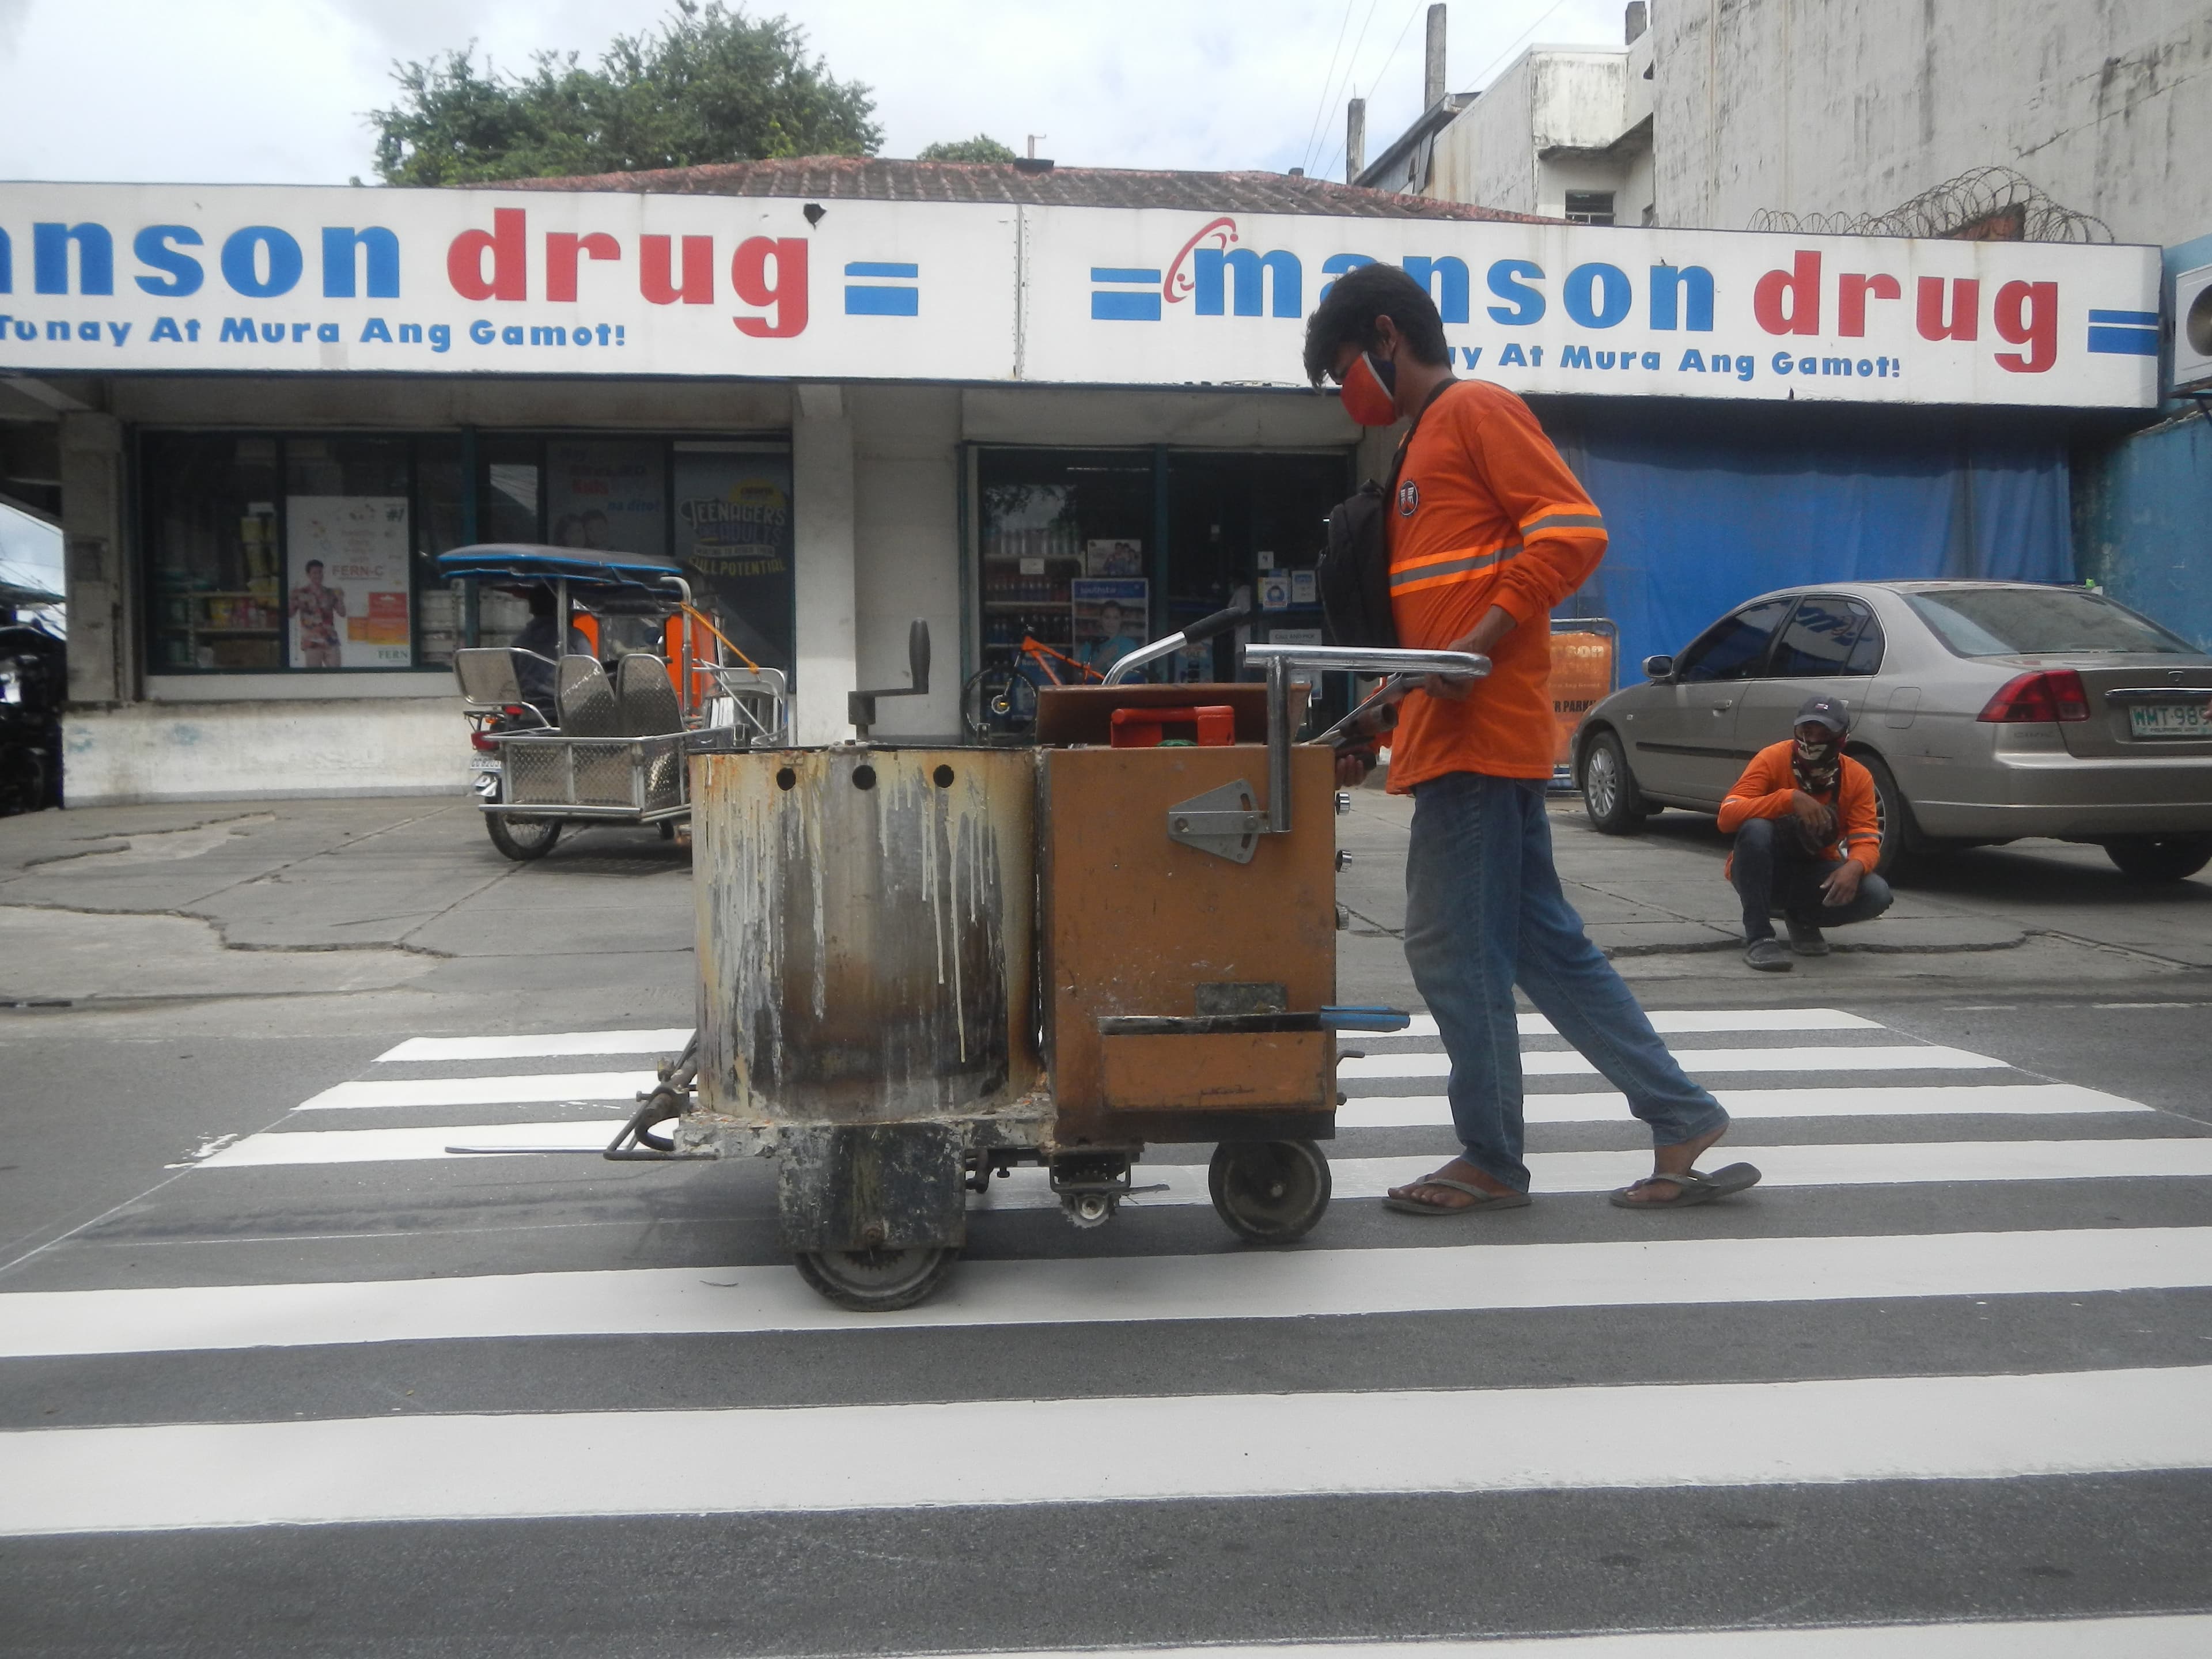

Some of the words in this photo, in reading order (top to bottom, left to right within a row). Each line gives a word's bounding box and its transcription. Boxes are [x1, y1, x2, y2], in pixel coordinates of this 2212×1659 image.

[0, 222, 400, 299] nson
[447, 208, 808, 339] drug
[1755, 251, 2057, 373] drug
[149, 317, 202, 343] At
[219, 317, 340, 344] Mura
[360, 318, 452, 354] Ang
[469, 320, 625, 347] Gamot!
[1498, 343, 1544, 367] At
[1559, 346, 1661, 370] Mura
[1677, 349, 1754, 382] Ang
[1771, 351, 1900, 378] Gamot!
[679, 498, 786, 529] TEENAGERS
[718, 523, 782, 546] ADULTS
[332, 565, 384, 576] FERN-C
[719, 557, 786, 577] POTENTIAL
[378, 650, 408, 659] FERN
